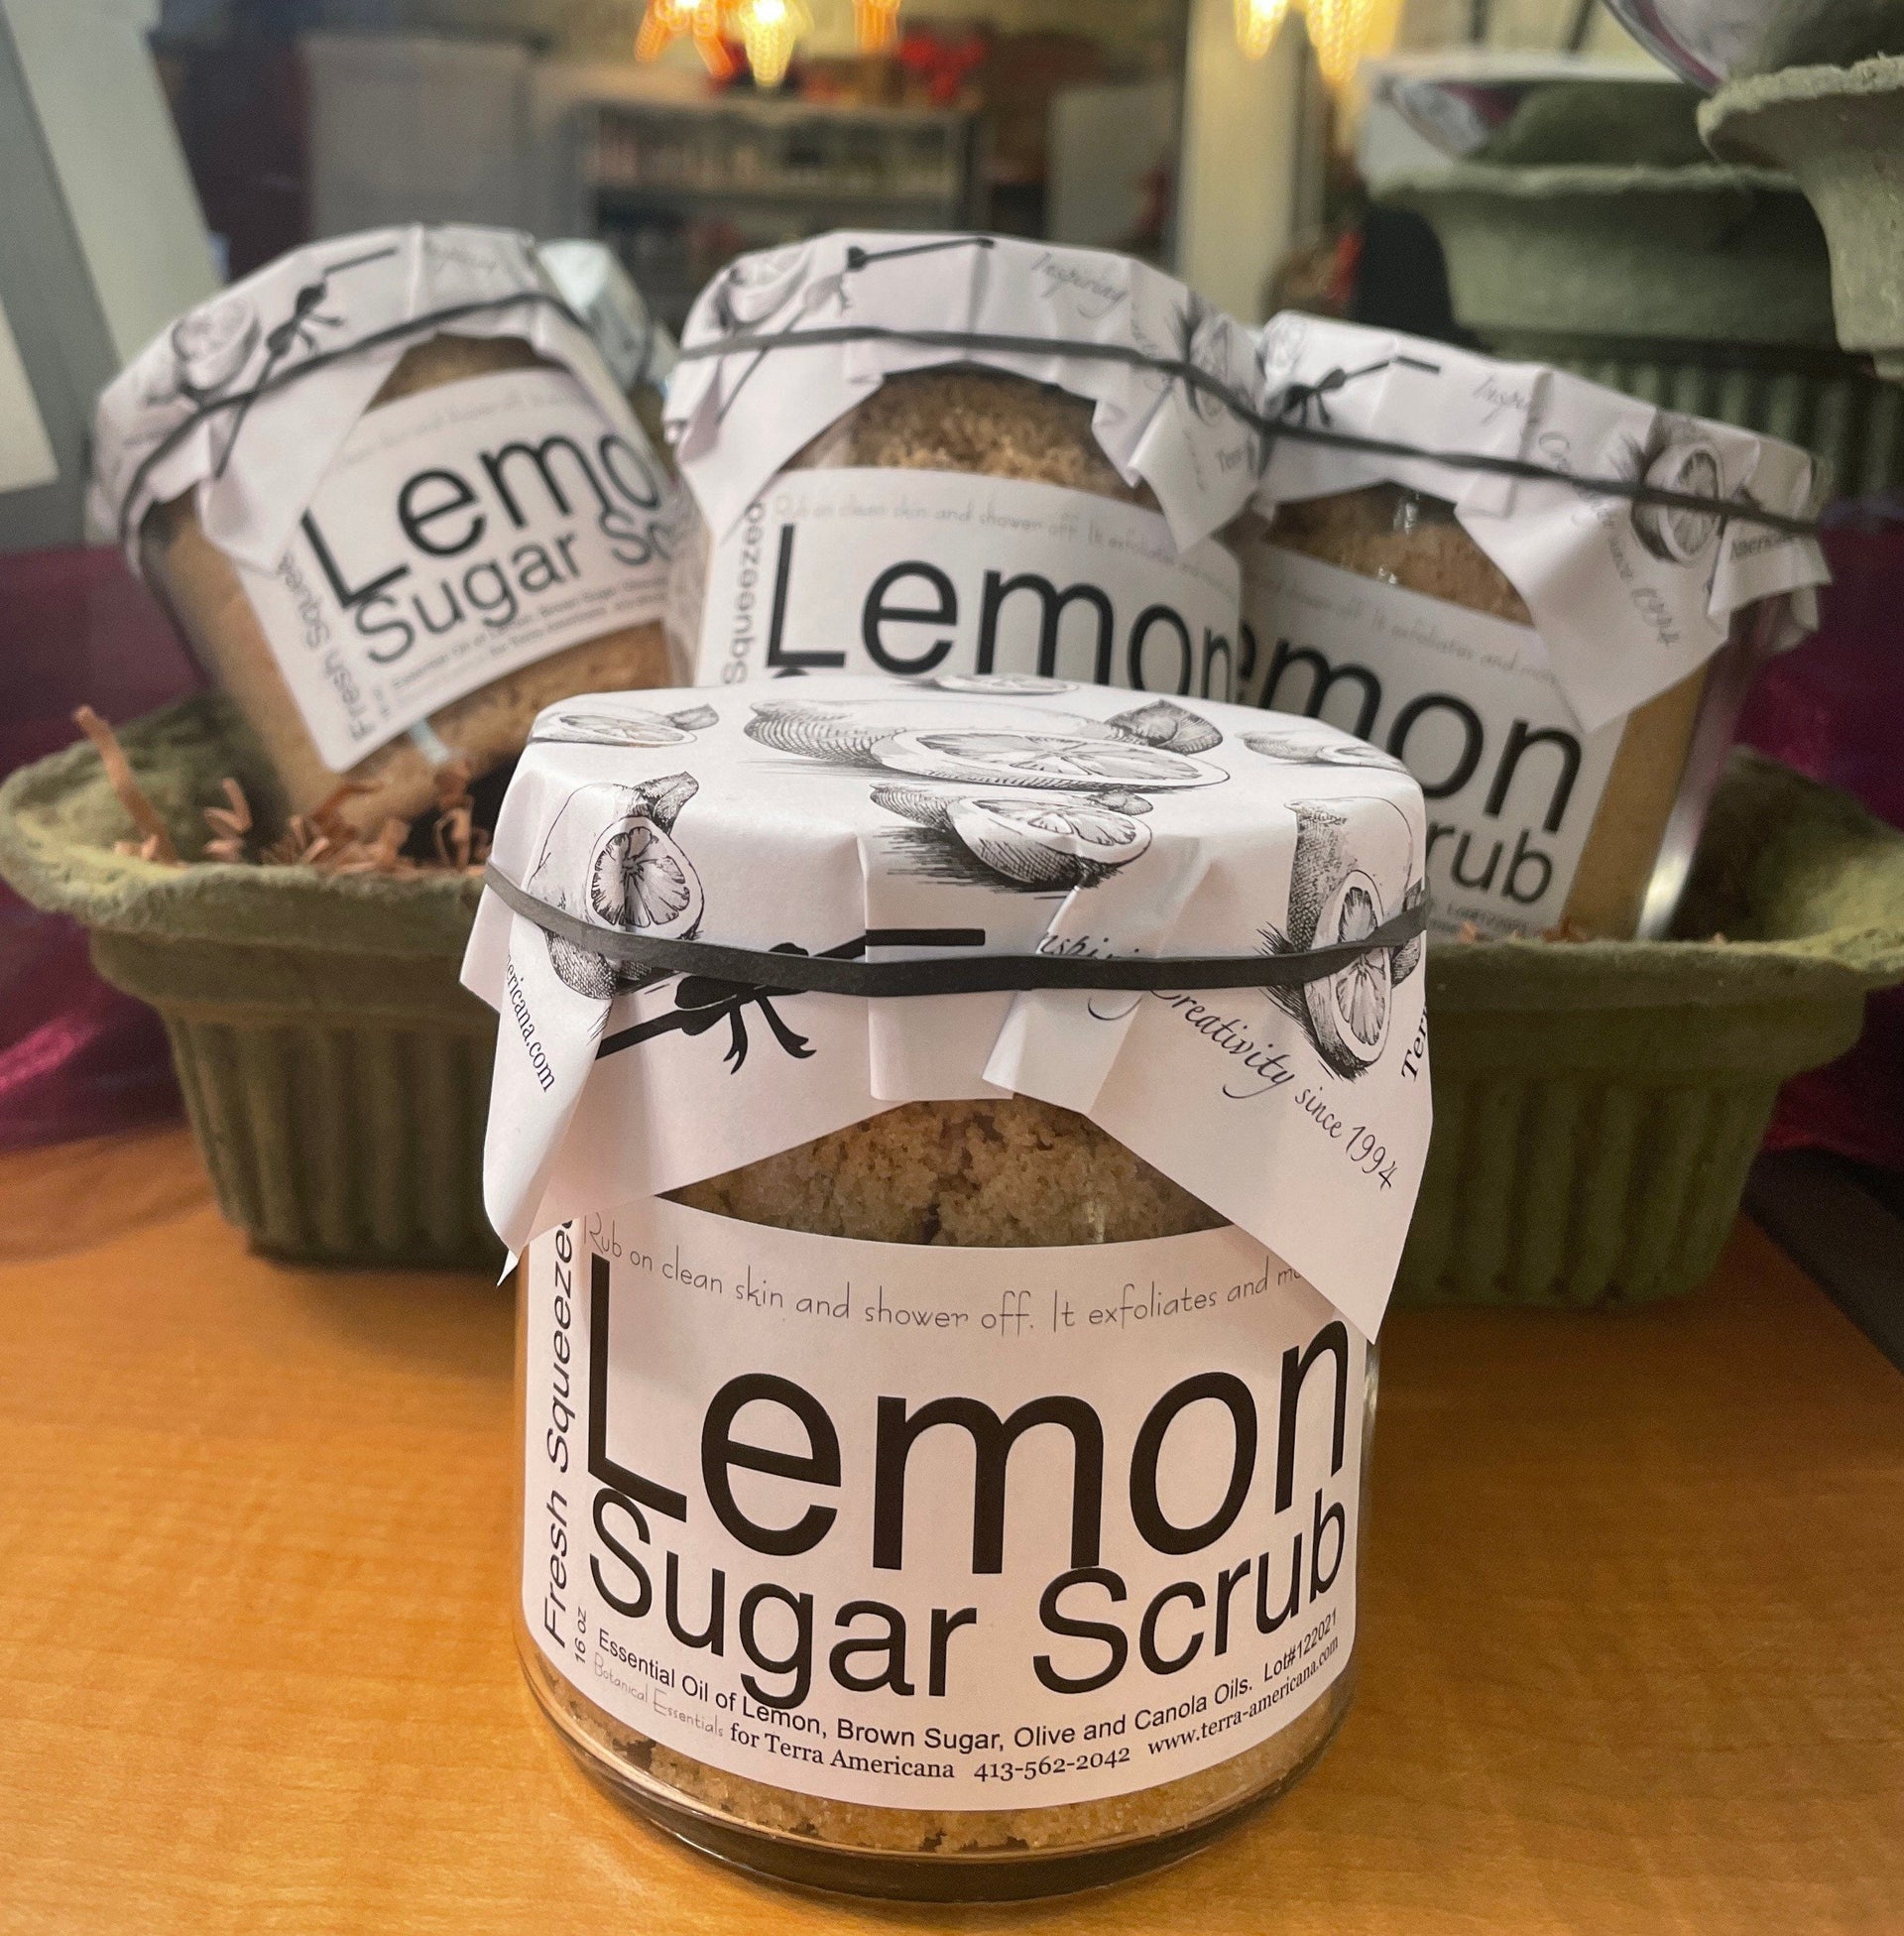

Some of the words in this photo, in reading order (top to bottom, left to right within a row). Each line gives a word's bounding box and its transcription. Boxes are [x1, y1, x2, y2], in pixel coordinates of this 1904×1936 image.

[354, 531, 581, 665] Sugar
[765, 523, 1233, 698] Lemon
[507, 954, 555, 1093] ericana.com
[1400, 1008, 1426, 1083] Ter
[1294, 1087, 1343, 1139] since
[1345, 1127, 1397, 1191] 1994
[583, 1211, 623, 1259] Rub
[630, 1250, 654, 1272] on
[661, 1245, 723, 1295] clean
[735, 1265, 783, 1309] skin
[795, 1281, 850, 1319] and
[865, 1284, 969, 1328] shower
[981, 1290, 1034, 1339] off.
[1053, 1289, 1076, 1333] It
[1088, 1280, 1218, 1331] exfoliates
[1227, 1255, 1269, 1303] and
[588, 1252, 1349, 1574] Lemon
[543, 1490, 568, 1648] Fresh
[576, 1606, 588, 1634] oz
[589, 1487, 977, 1710] Sugar
[1032, 1489, 1346, 1694] Scrub
[574, 1637, 587, 1664] 16
[594, 1651, 649, 1705] Botanical
[653, 1689, 724, 1739] Essentials
[730, 1723, 760, 1749] for
[765, 1733, 824, 1765] Terra
[829, 1749, 955, 1780] Americana
[973, 1746, 1131, 1783] 413-562-2042
[1146, 1634, 1340, 1756] www.terra-americana.com
[598, 1627, 676, 1689] Essential
[681, 1674, 709, 1703] Oil
[715, 1690, 737, 1713] of
[742, 1695, 829, 1740] Lemon,
[837, 1717, 915, 1748] Brown
[923, 1727, 1006, 1754] Sugar,
[1013, 1725, 1076, 1750] Olive
[1083, 1713, 1127, 1741] and
[1133, 1694, 1208, 1731] Canola
[1214, 1676, 1253, 1705] Oils.
[1262, 1606, 1339, 1683] Lot#122021
